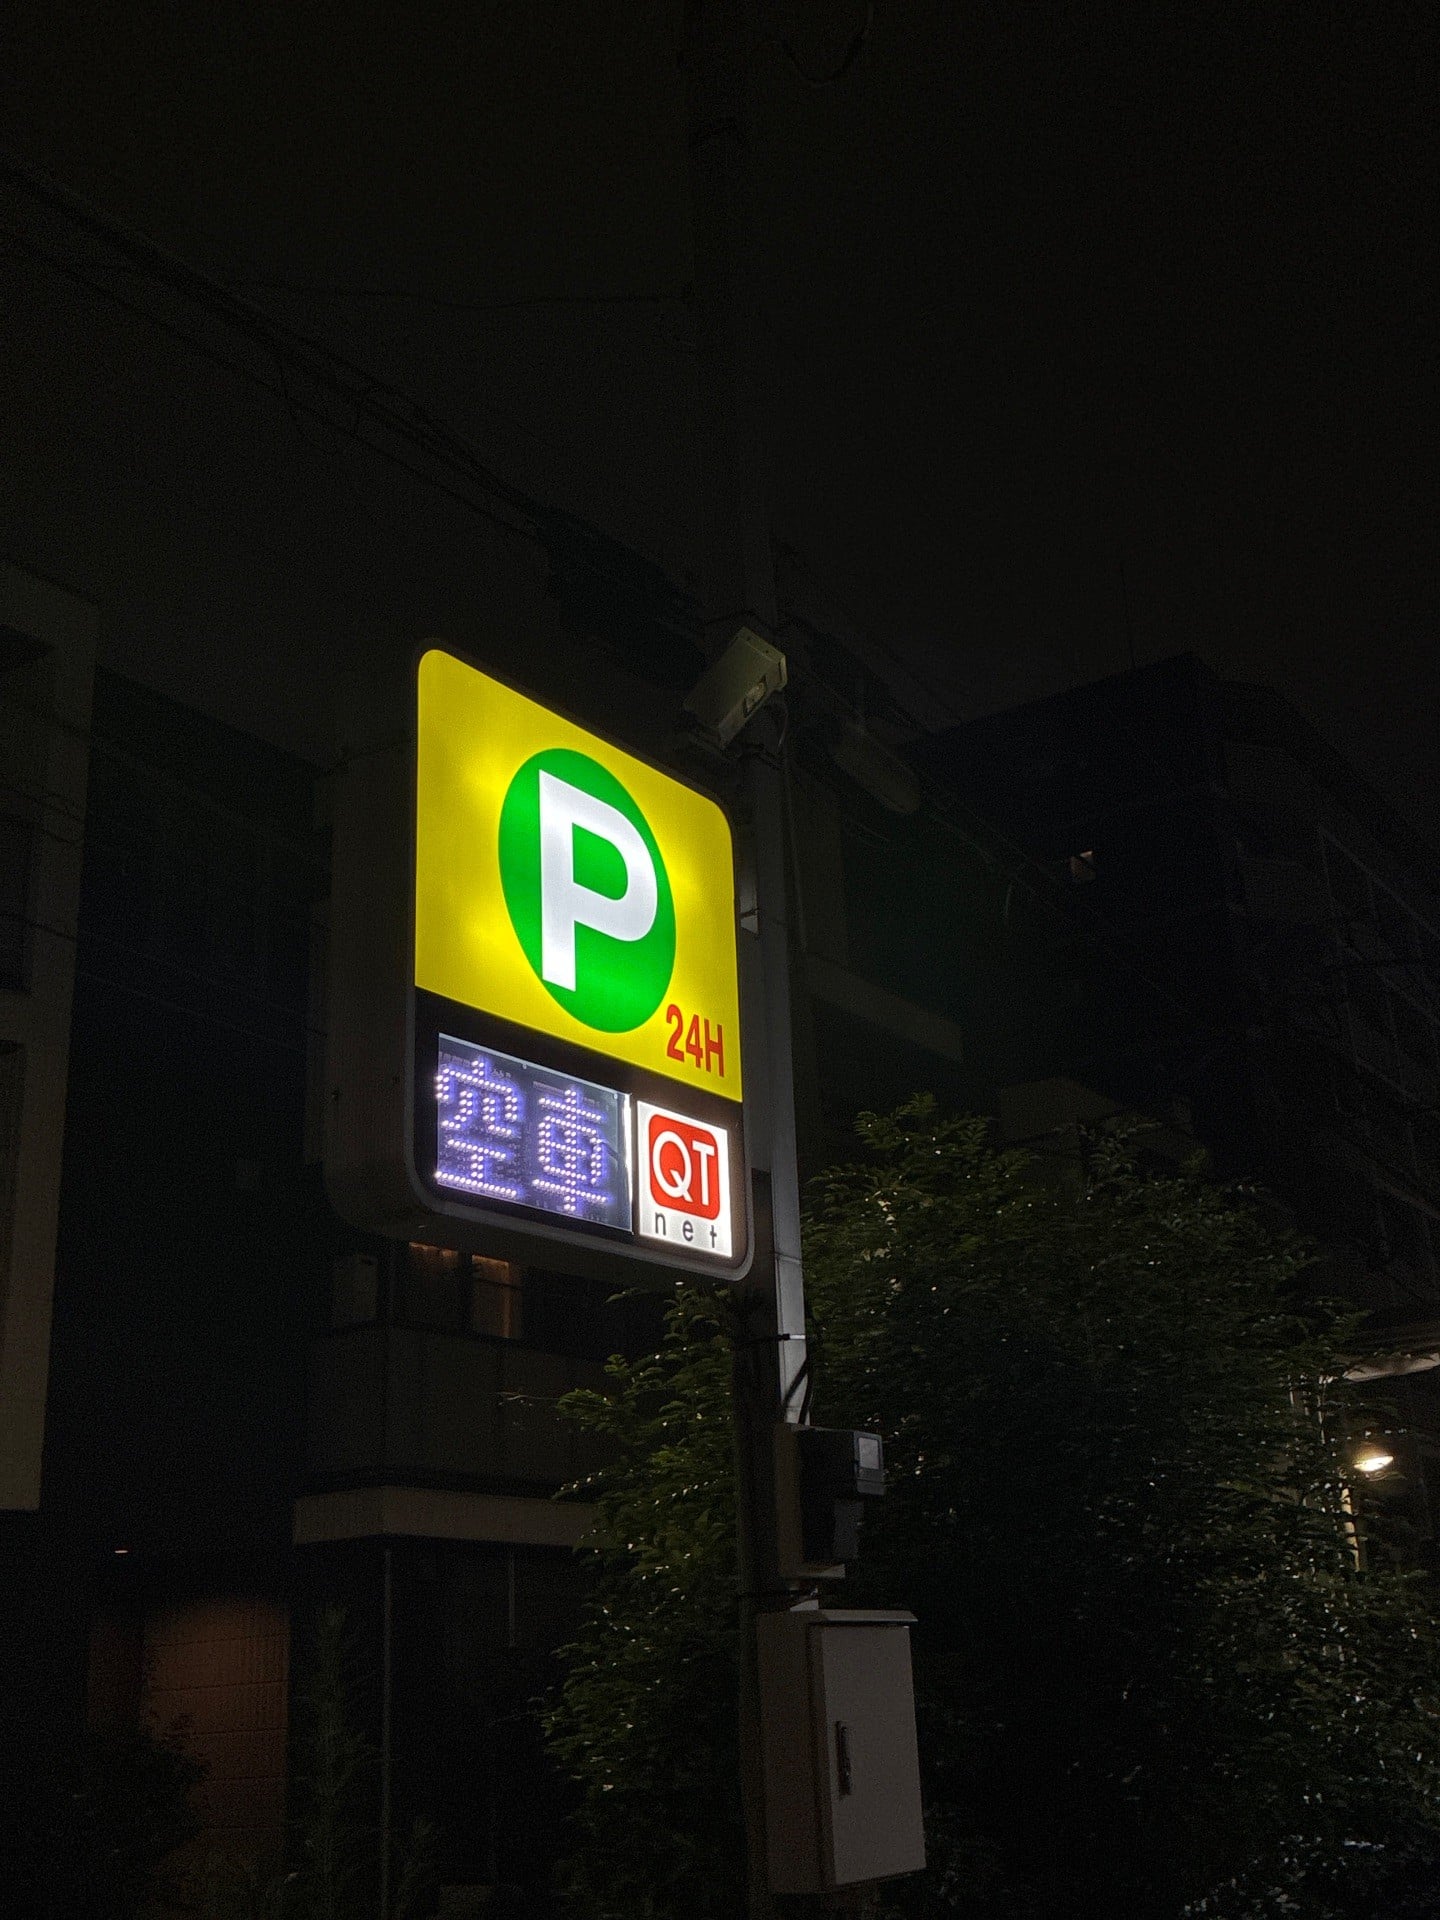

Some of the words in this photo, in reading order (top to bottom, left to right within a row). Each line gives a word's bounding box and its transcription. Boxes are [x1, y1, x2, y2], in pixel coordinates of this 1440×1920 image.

[538, 769, 657, 992] P
[666, 1003, 724, 1077] 24H
[434, 1059, 607, 1212] 空車
[652, 1131, 716, 1207] QT
[655, 1213, 717, 1249] net
